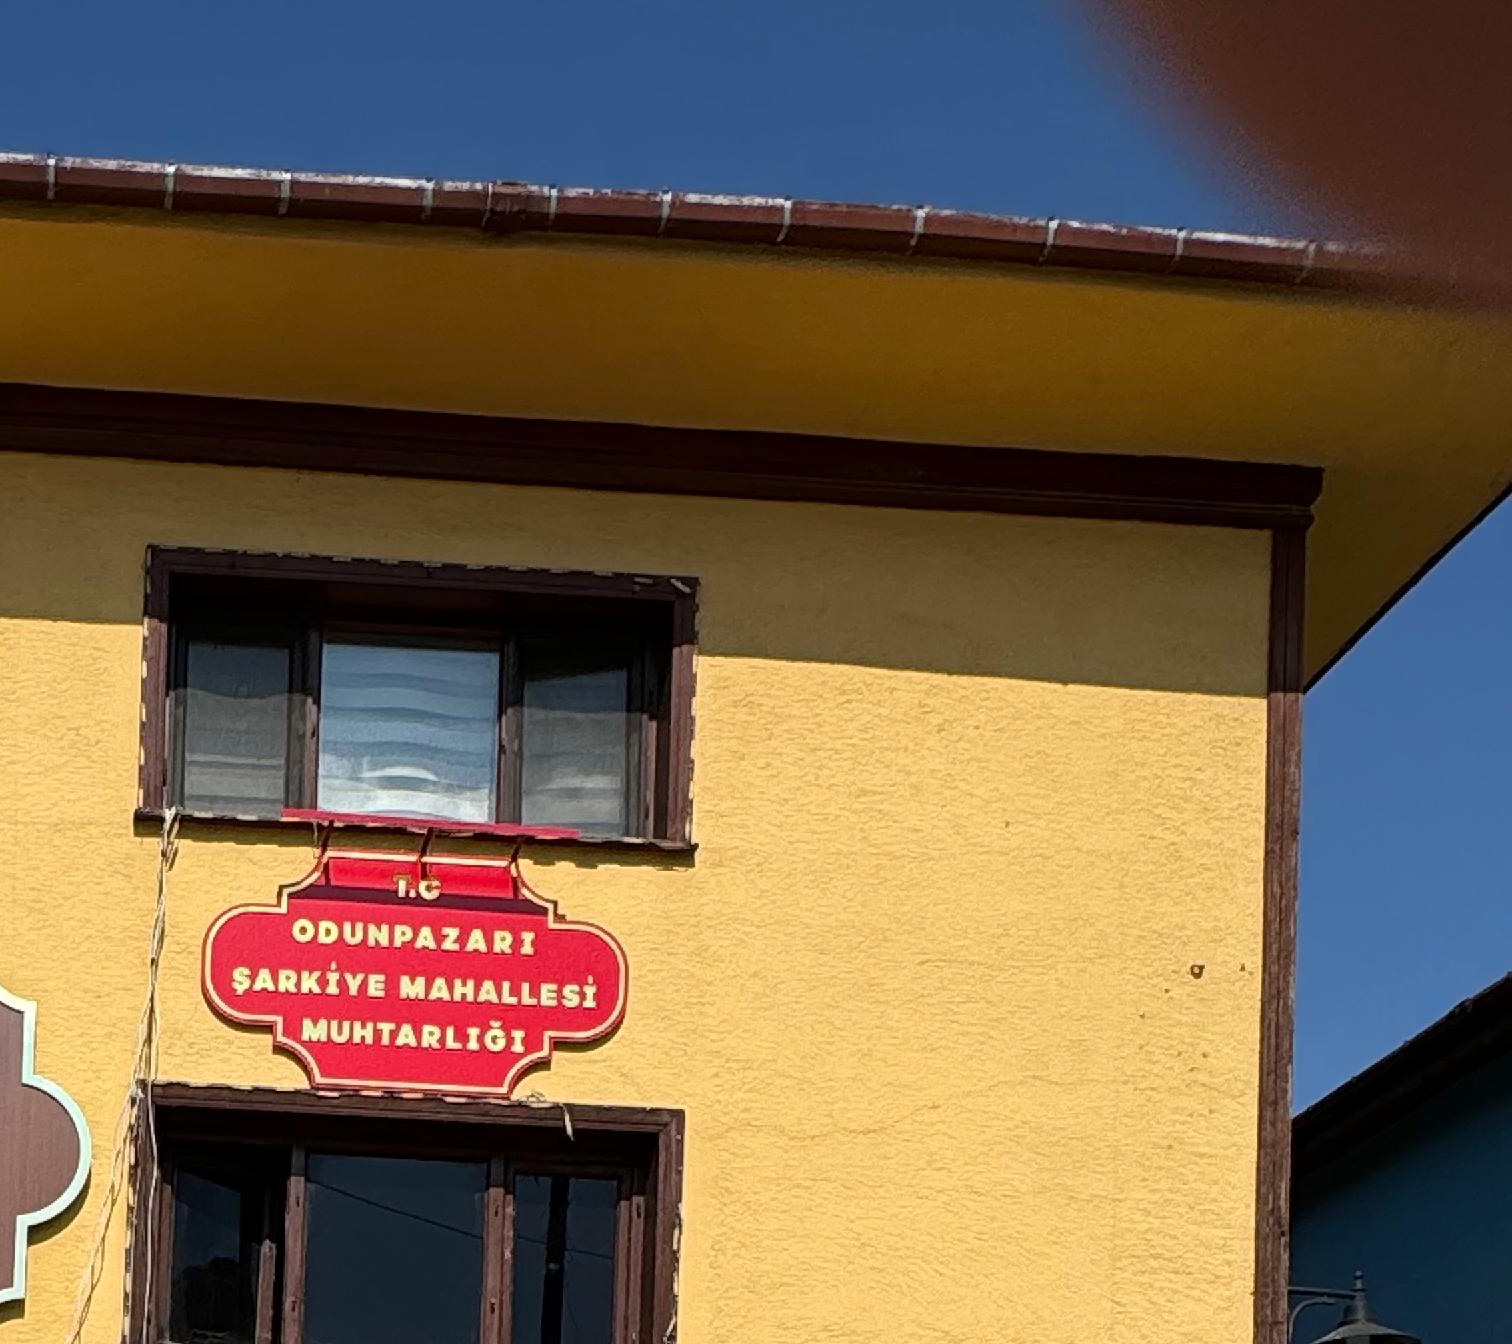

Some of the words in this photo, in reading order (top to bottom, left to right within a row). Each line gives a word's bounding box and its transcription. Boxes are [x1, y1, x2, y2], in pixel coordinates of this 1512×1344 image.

[291, 918, 537, 956] ODUNPAZARI
[231, 960, 386, 998] ŞARKİYE
[398, 975, 598, 1010] MAHALLESİ
[301, 1017, 527, 1055] MUHTARLIĞI
